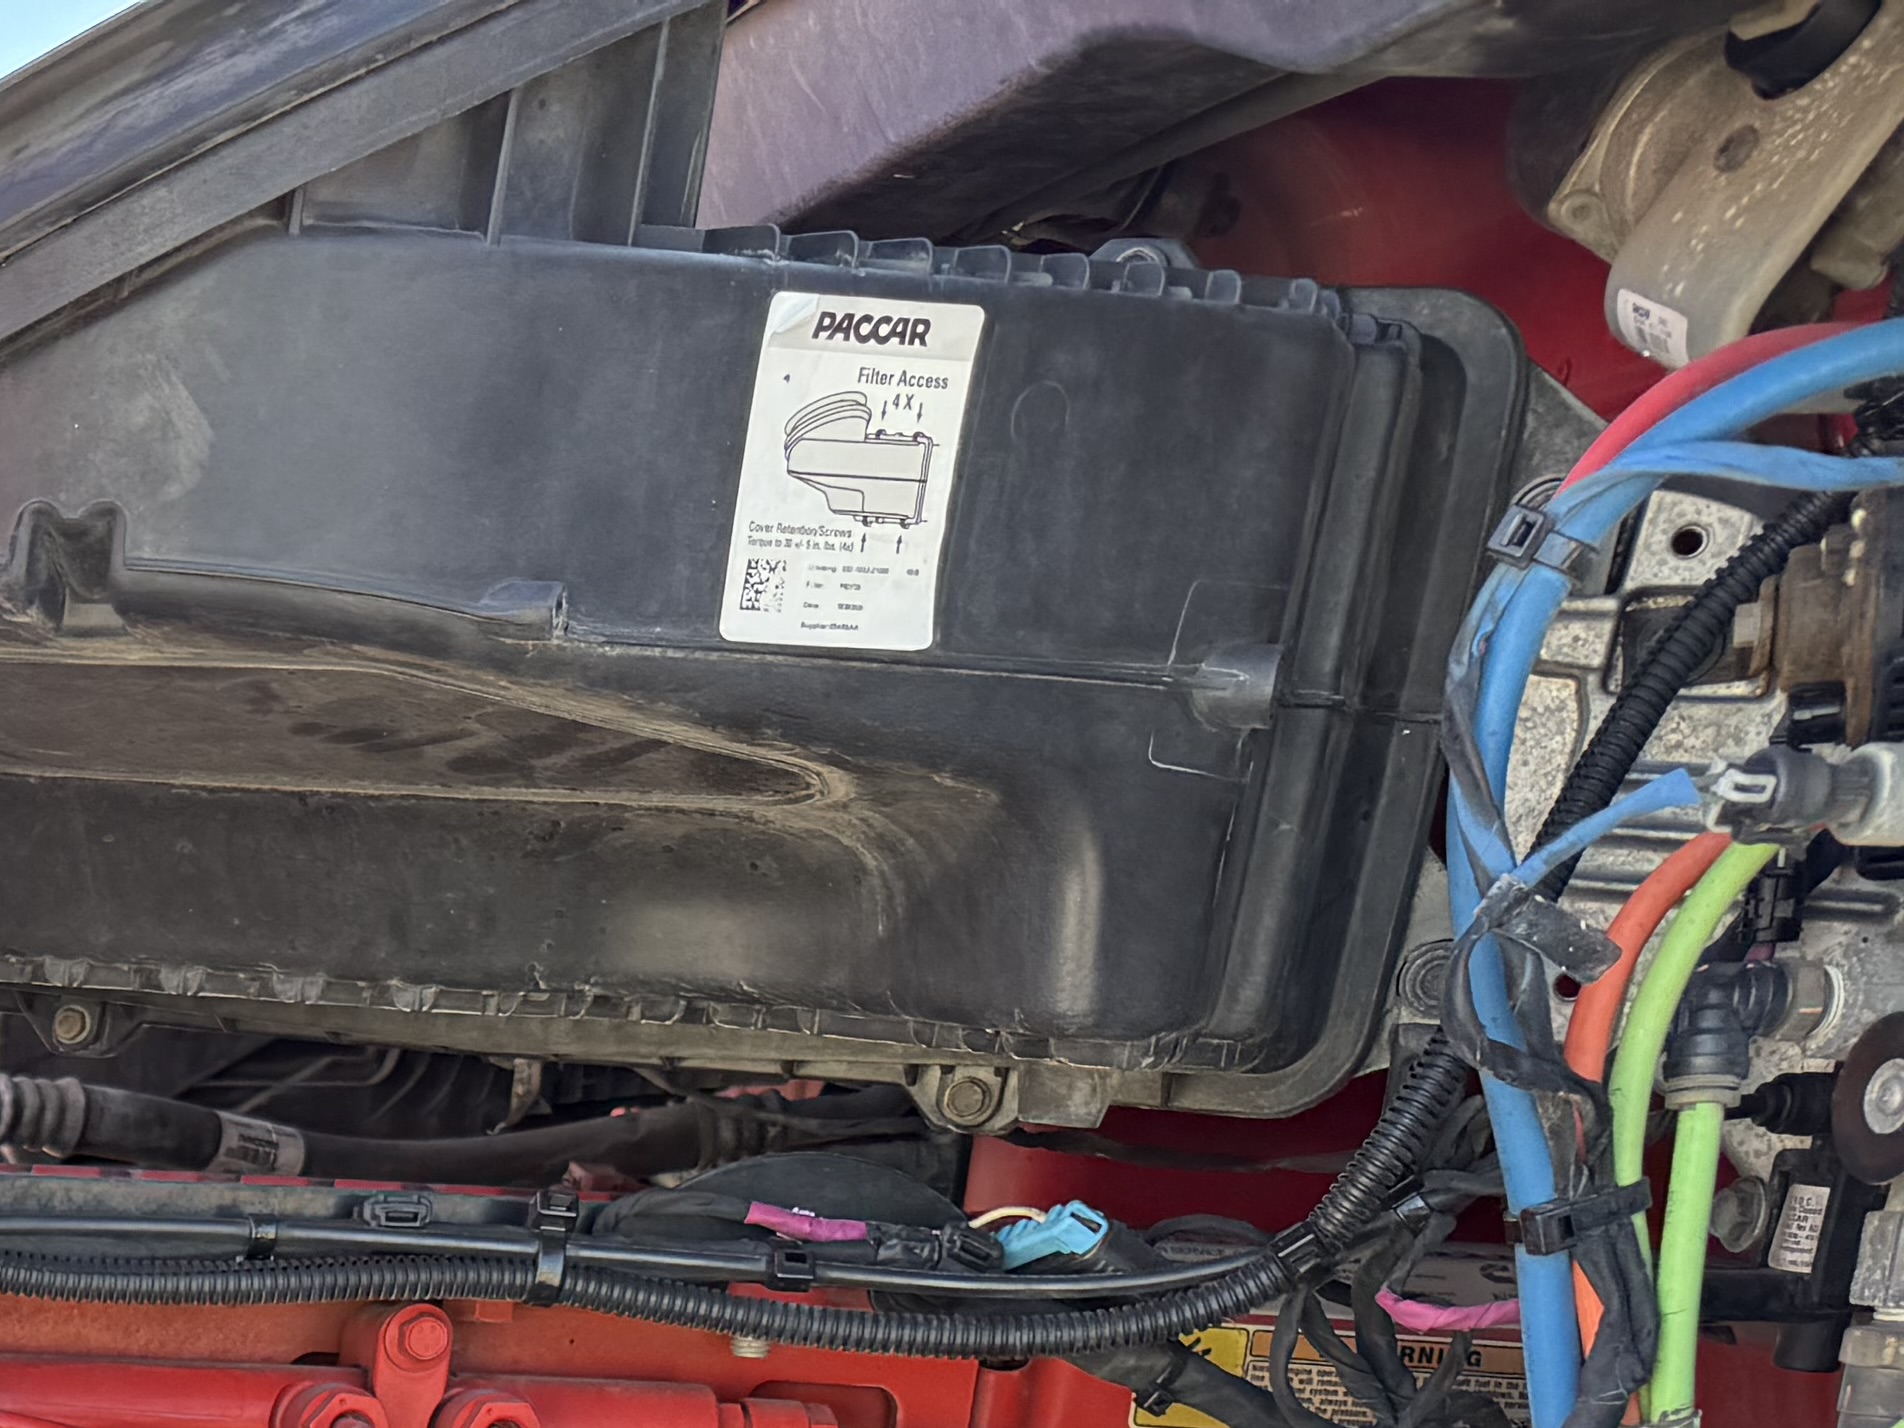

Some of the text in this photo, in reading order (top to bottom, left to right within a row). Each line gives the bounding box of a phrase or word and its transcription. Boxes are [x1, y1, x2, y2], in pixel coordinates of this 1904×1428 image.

[812, 312, 931, 347] PACCAR
[858, 367, 948, 389] Filter Access
